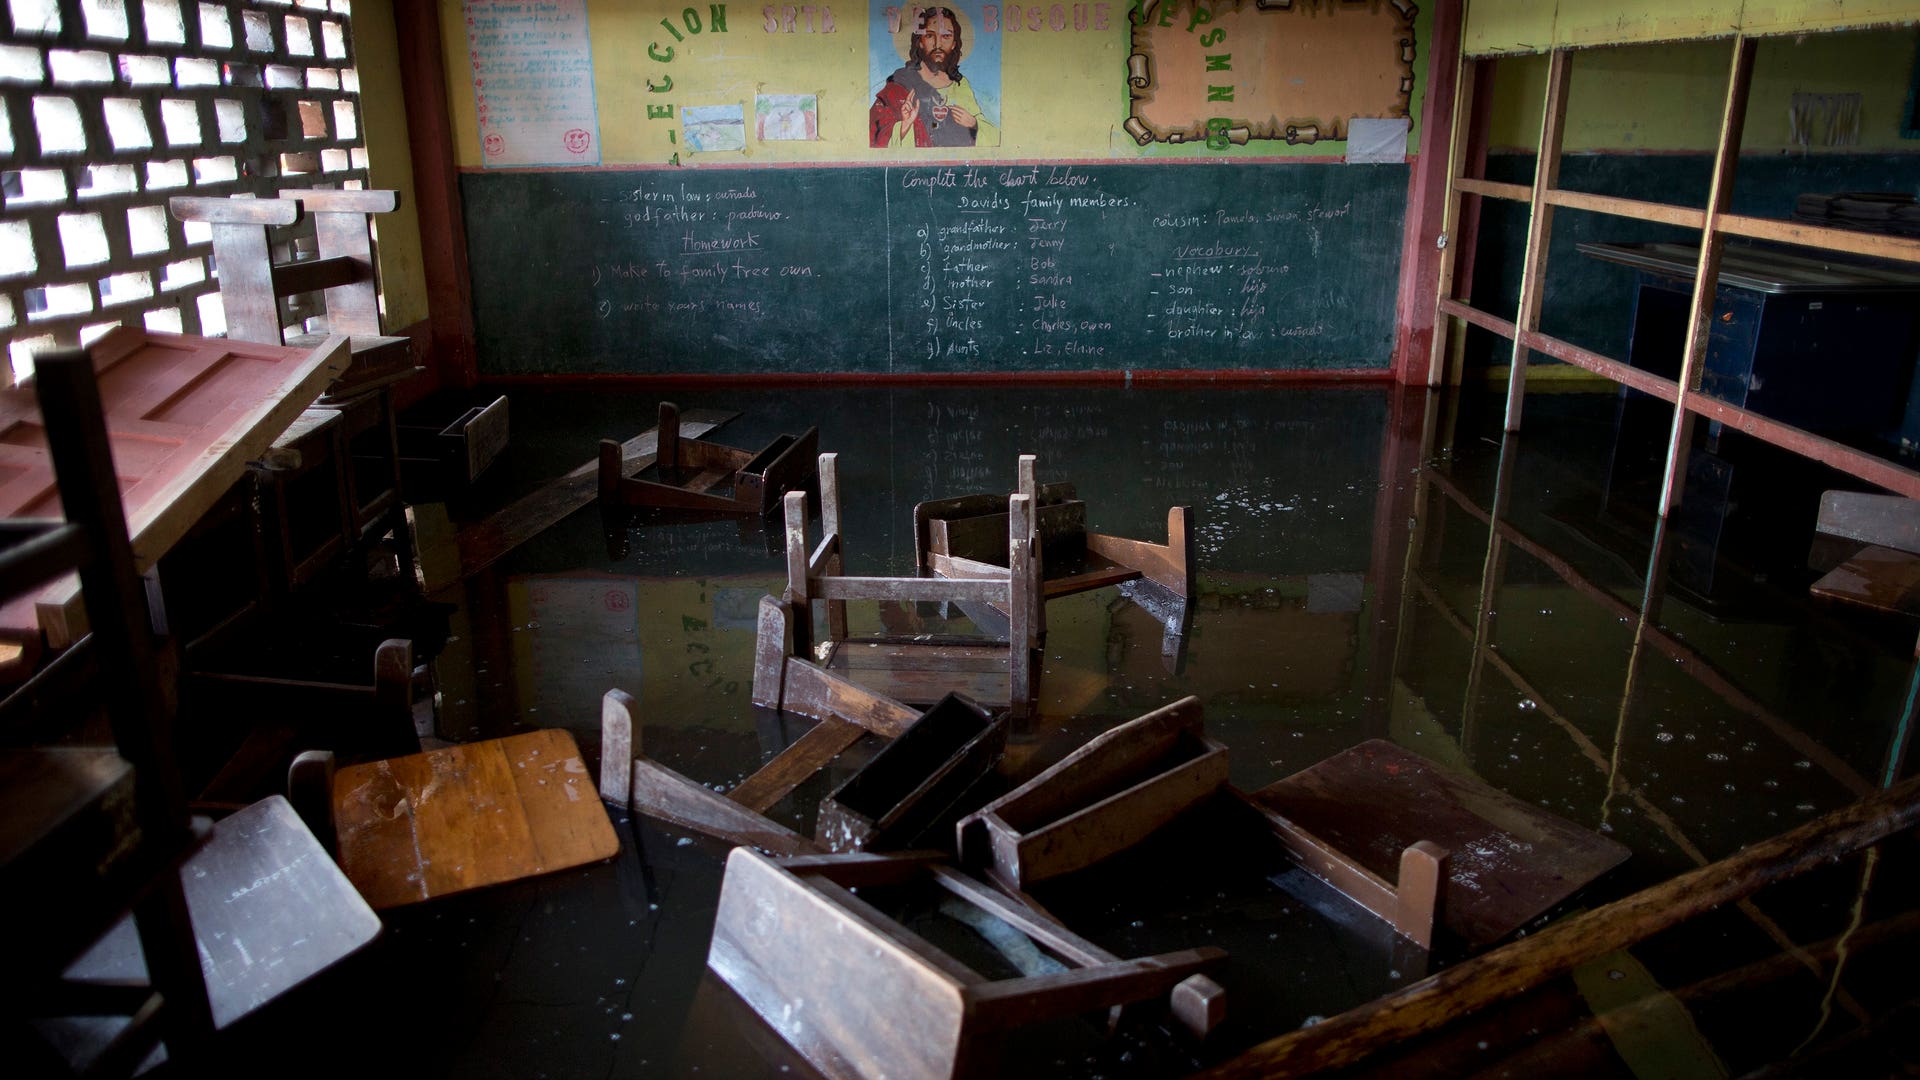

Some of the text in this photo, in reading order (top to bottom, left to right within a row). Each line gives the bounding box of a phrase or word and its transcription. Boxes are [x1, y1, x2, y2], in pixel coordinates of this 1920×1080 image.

[763, 5, 836, 33] SRTA
[902, 167, 957, 197] Complete
[963, 167, 988, 187] the
[662, 191, 674, 202] in
[1021, 190, 1063, 216] family
[681, 230, 761, 251] Homework
[1028, 236, 1064, 252] Jenny
[611, 261, 648, 277] Make
[680, 262, 729, 286] family
[731, 257, 770, 280] tree
[943, 258, 989, 281] father
[1030, 257, 1056, 270] Bob
[947, 275, 995, 289] mother
[1029, 273, 1073, 286] Sandra
[1168, 283, 1194, 296] son
[1033, 294, 1067, 312] Julie
[1167, 319, 1218, 339] brother
